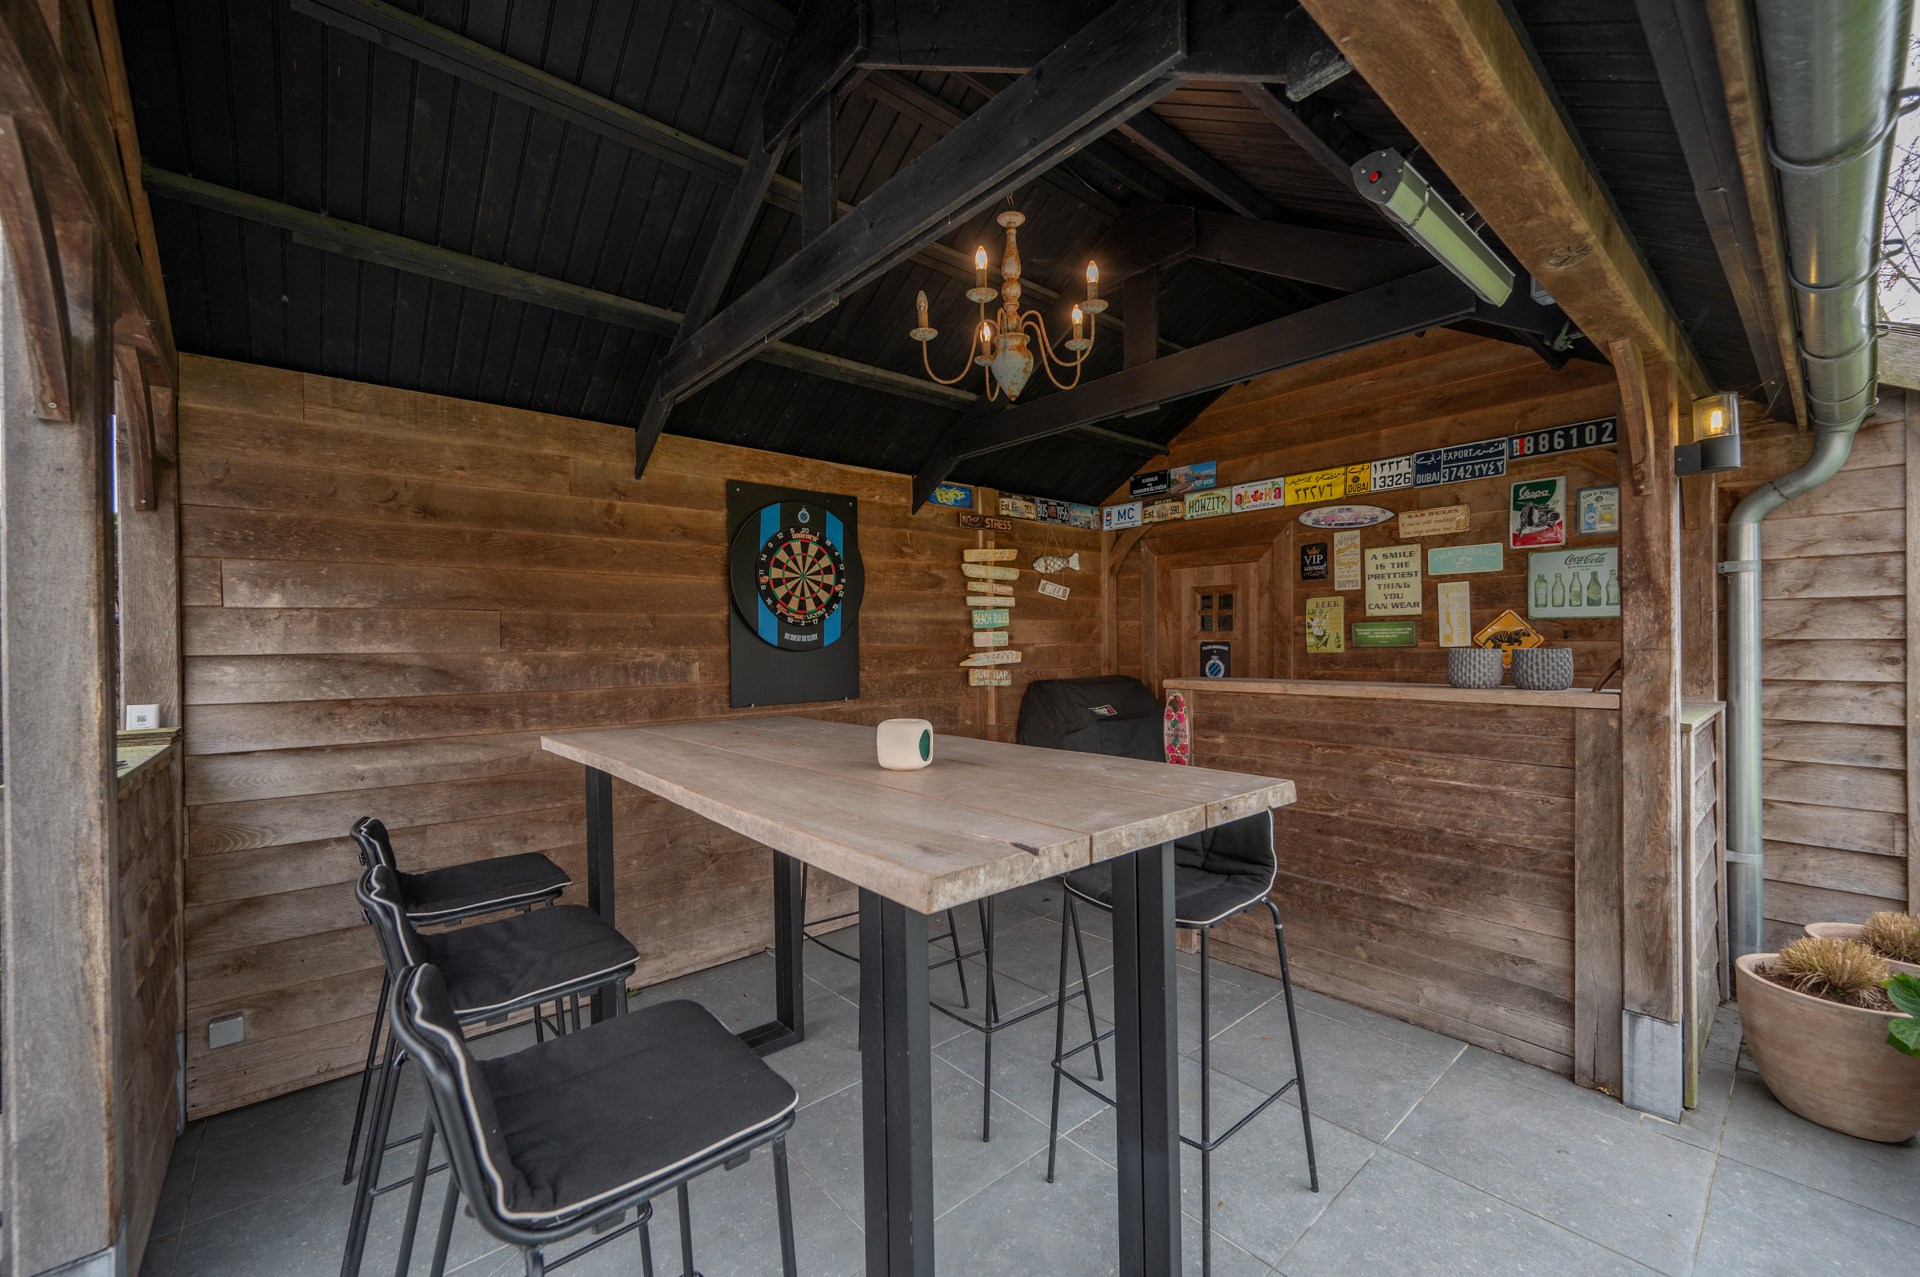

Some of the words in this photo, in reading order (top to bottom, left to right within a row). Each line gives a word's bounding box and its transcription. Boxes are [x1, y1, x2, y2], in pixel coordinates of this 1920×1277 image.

[1524, 422, 1614, 455] 886102
[1443, 449, 1472, 461] EXPORT
[1417, 470, 1441, 484] DUBAI
[1443, 465, 1472, 481] 3742
[1373, 471, 1411, 489] 13326
[1348, 481, 1369, 492] DUBAI
[1517, 486, 1551, 500] Vespa
[1599, 490, 1616, 498] TONIC
[1188, 495, 1227, 514] HOWZIT?
[1037, 503, 1048, 518] BUS
[1056, 506, 1069, 521] 1956
[1117, 508, 1135, 522] MC
[1428, 509, 1458, 517] RULES
[985, 517, 1012, 531] STRESS
[791, 532, 819, 542] unicorn
[1303, 554, 1324, 565] VIP
[1382, 550, 1415, 560] SMILE
[1564, 552, 1609, 565] Coca-Cola
[966, 565, 986, 576] GONE
[1390, 561, 1410, 569] THE
[1367, 571, 1419, 581] PRETTIEST
[1377, 582, 1410, 590] THING
[1383, 592, 1404, 600] YOU
[1368, 602, 1388, 610] CAN
[1391, 601, 1420, 609] WEAR
[786, 616, 794, 624] 19
[974, 612, 992, 625] BEACH
[993, 612, 1009, 625] RULES
[974, 669, 990, 679] SUN
[993, 670, 1009, 680] NAP
